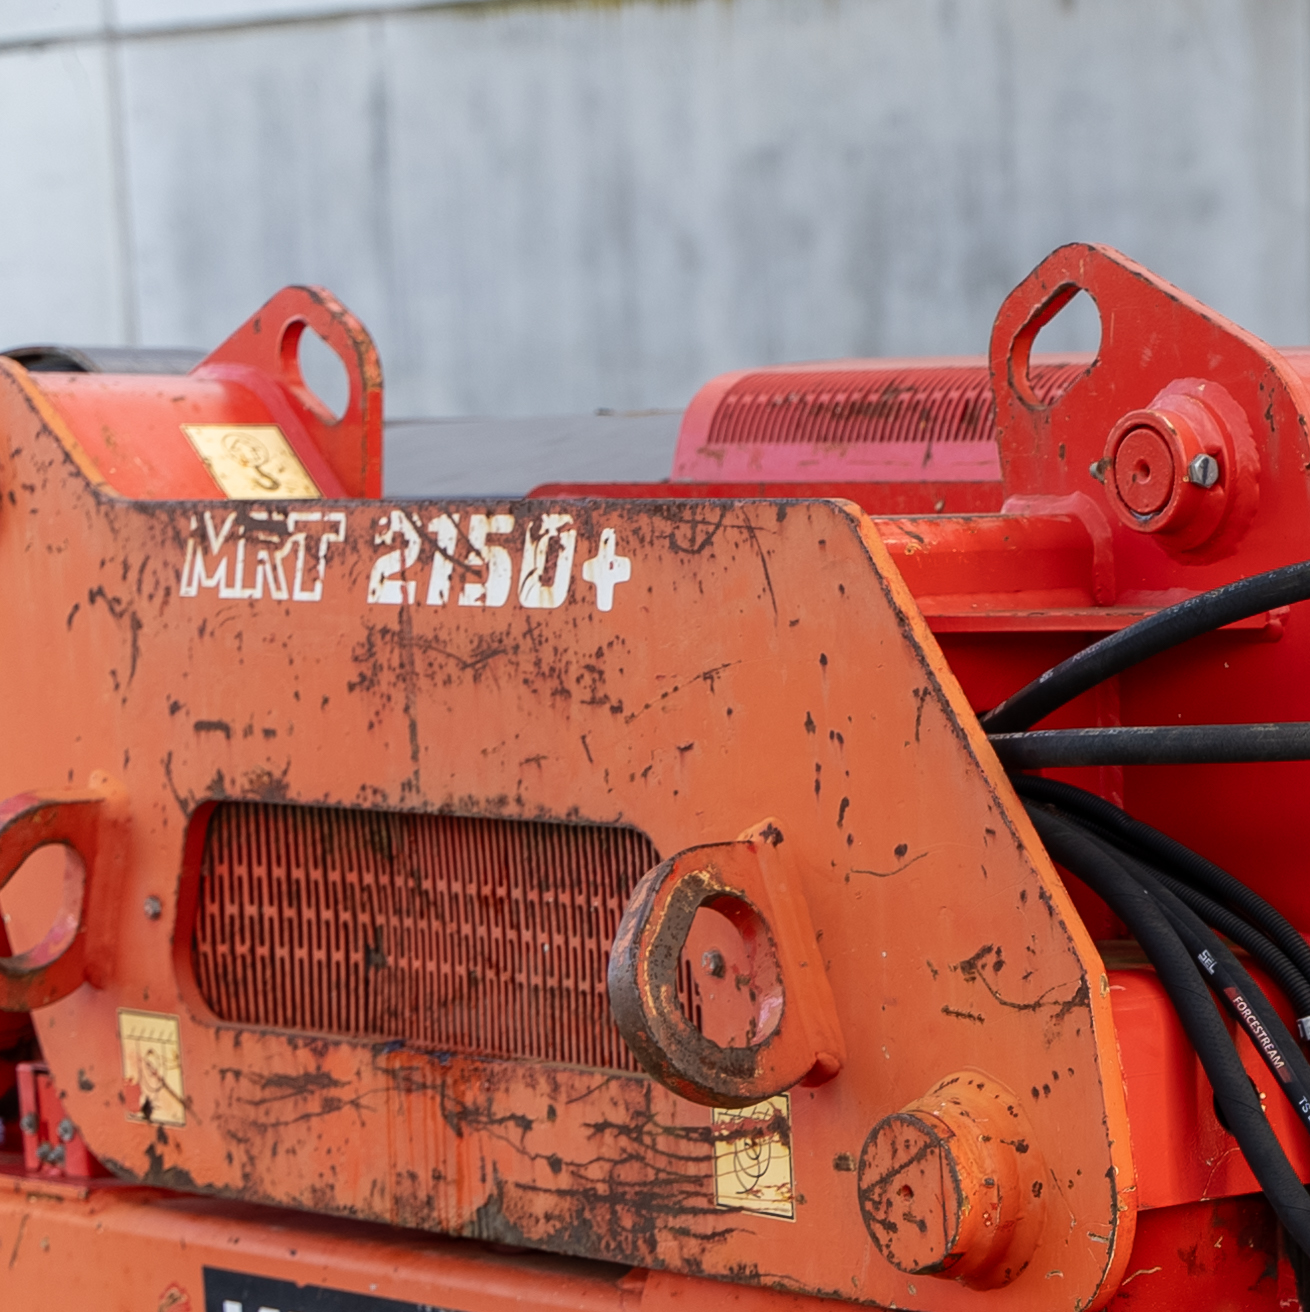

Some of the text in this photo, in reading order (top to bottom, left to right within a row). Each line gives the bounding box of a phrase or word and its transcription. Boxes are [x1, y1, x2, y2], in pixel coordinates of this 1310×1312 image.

[179, 508, 632, 612] MRT 2150+
[1232, 995, 1285, 1069] FORCESTREAM
